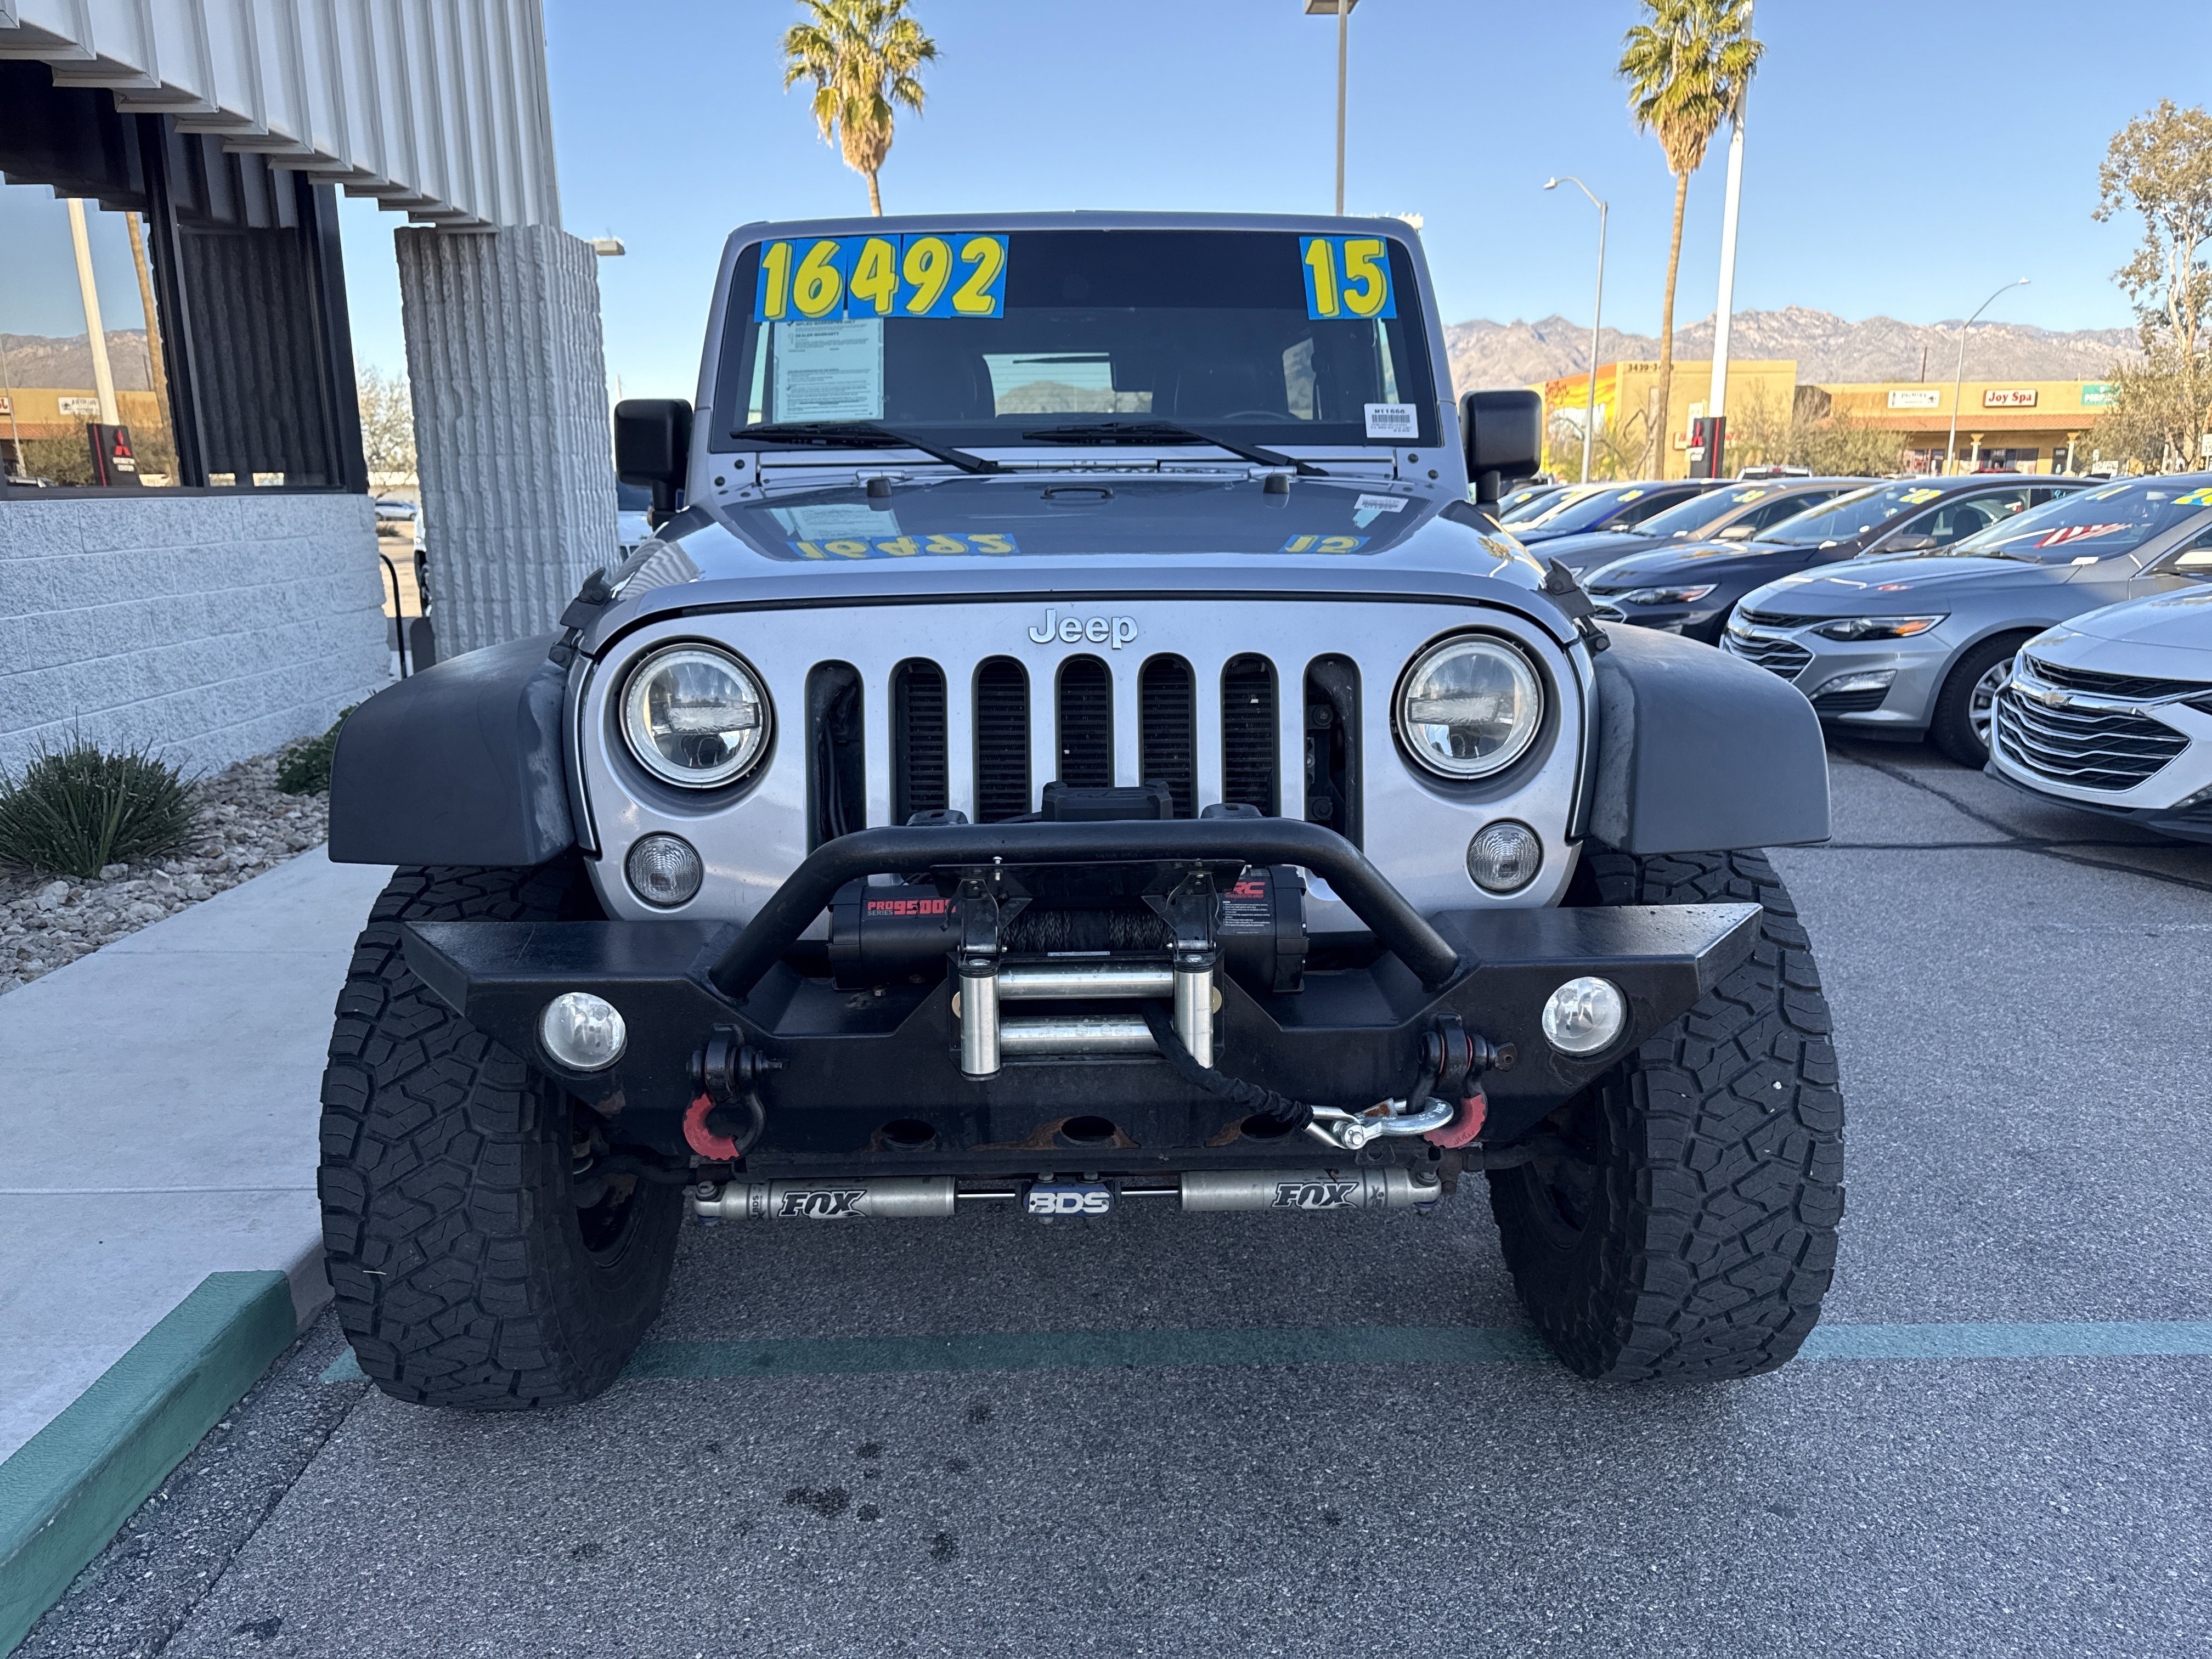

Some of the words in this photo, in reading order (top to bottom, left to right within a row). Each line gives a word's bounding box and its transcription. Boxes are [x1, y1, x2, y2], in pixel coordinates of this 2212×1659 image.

[760, 236, 1006, 320] 16492
[1304, 238, 1389, 318] 15
[1989, 392, 2008, 404] Joy
[2012, 391, 2032, 405] Spa
[1028, 608, 1138, 650] Jeep
[867, 901, 894, 911] PRO
[776, 1189, 868, 1219] FOX
[1028, 1192, 1110, 1214] BDS
[1269, 1181, 1360, 1209] FOX
